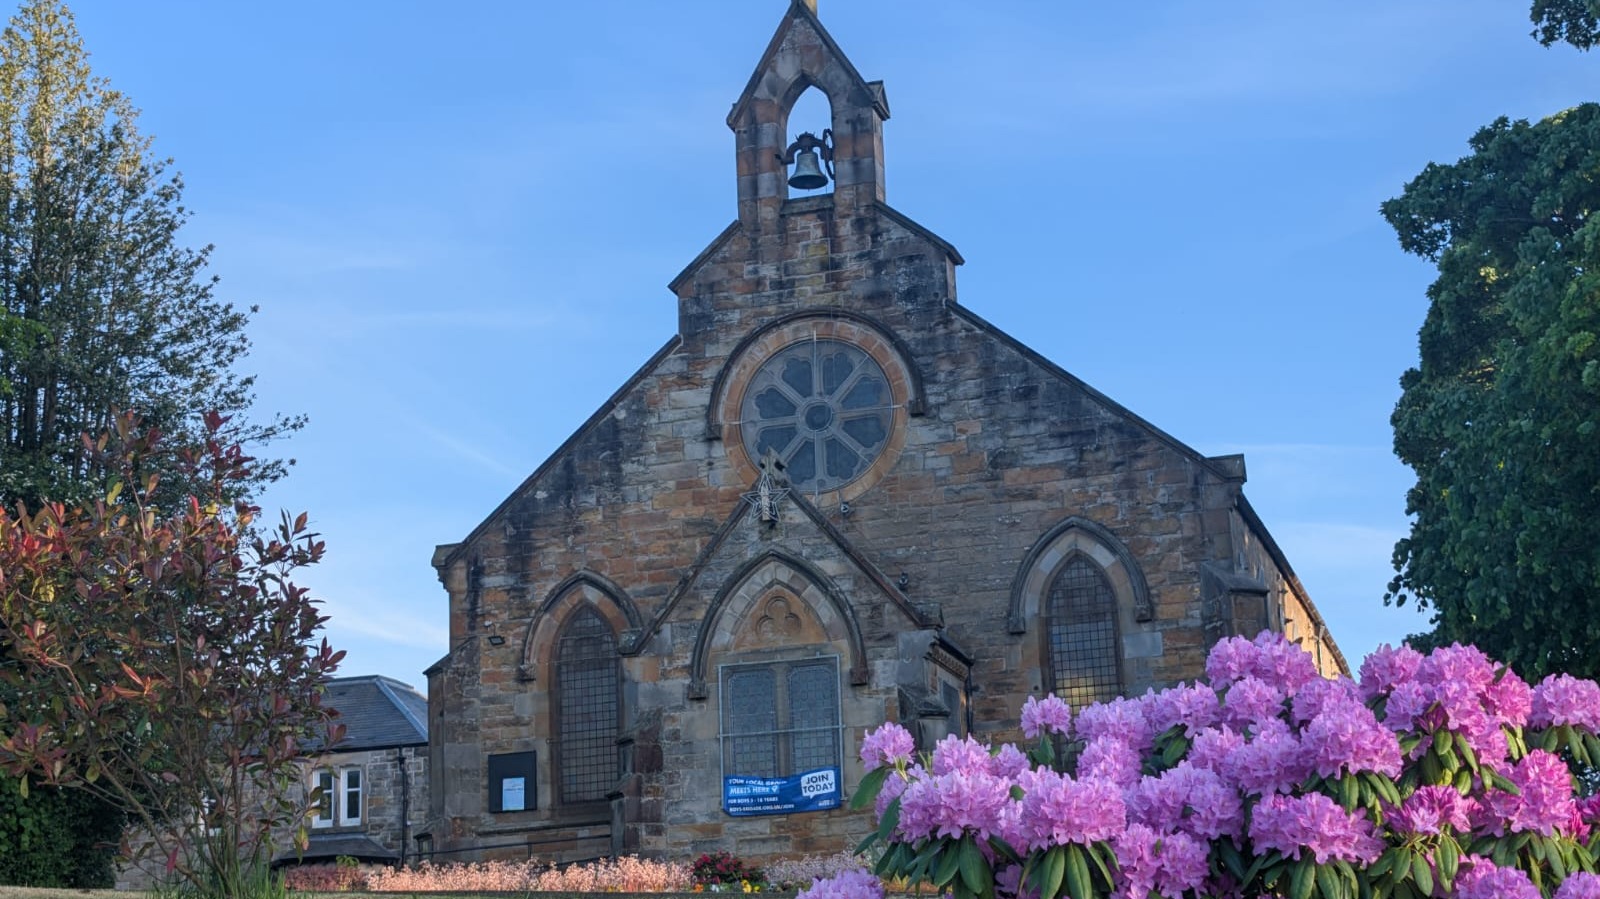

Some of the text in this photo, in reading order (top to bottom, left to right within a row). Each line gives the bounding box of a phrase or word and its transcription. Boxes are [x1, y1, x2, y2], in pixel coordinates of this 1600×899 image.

[806, 773, 829, 785] JOIN
[730, 786, 751, 795] MEETS
[803, 781, 833, 794] TODAY
